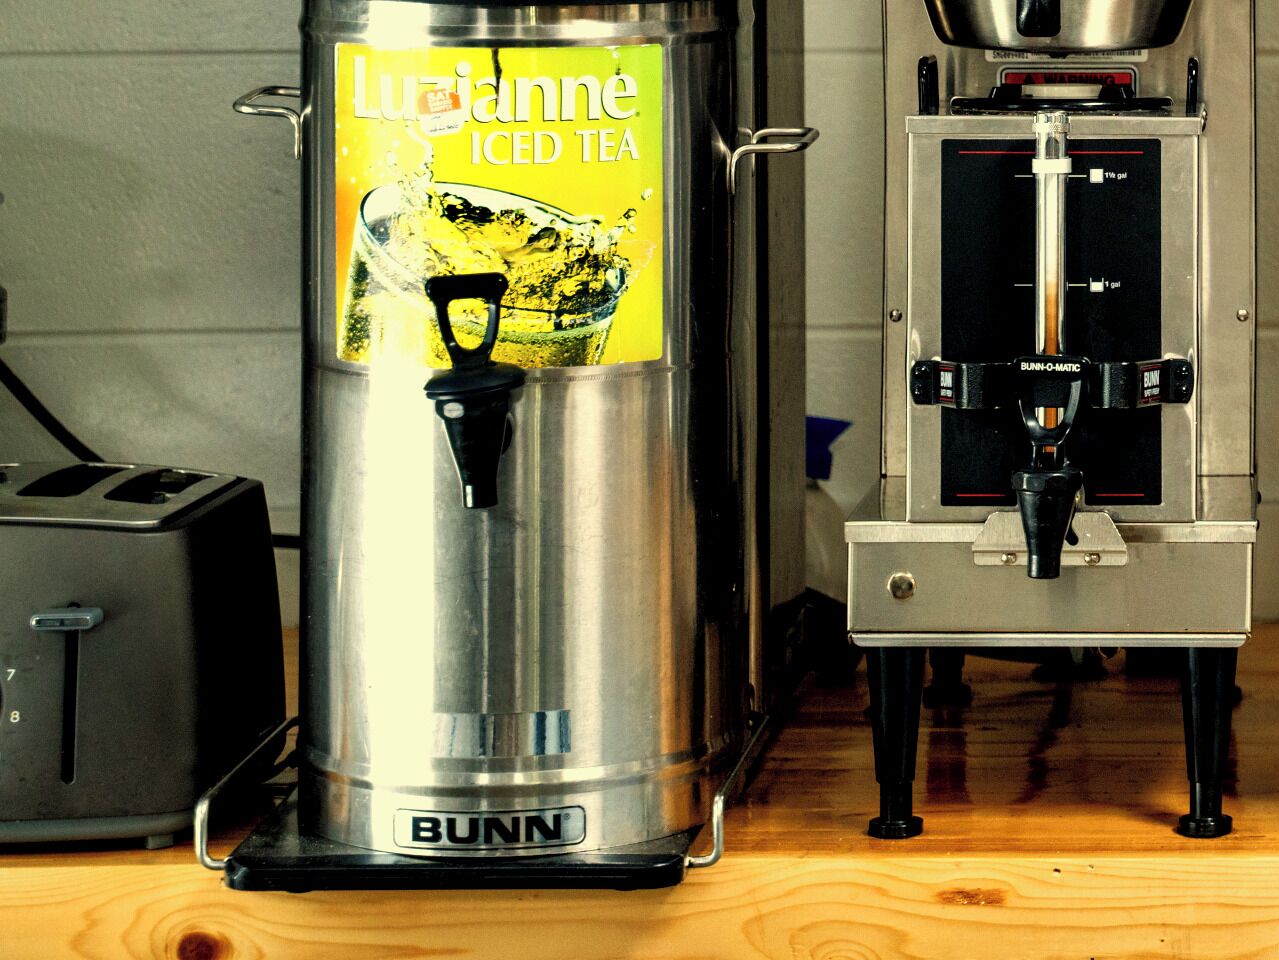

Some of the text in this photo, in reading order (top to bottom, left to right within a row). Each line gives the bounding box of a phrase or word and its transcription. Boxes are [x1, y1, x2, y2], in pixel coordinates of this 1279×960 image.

[1044, 75, 1116, 85] WARNING
[470, 128, 640, 165] ICED TEA
[1110, 280, 1121, 289] gal
[1021, 362, 1081, 372] BUNN-O-MATIC
[1144, 370, 1160, 387] BUNN
[6, 669, 16, 681] 7
[10, 711, 20, 723] 8
[411, 814, 562, 844] BUNN
